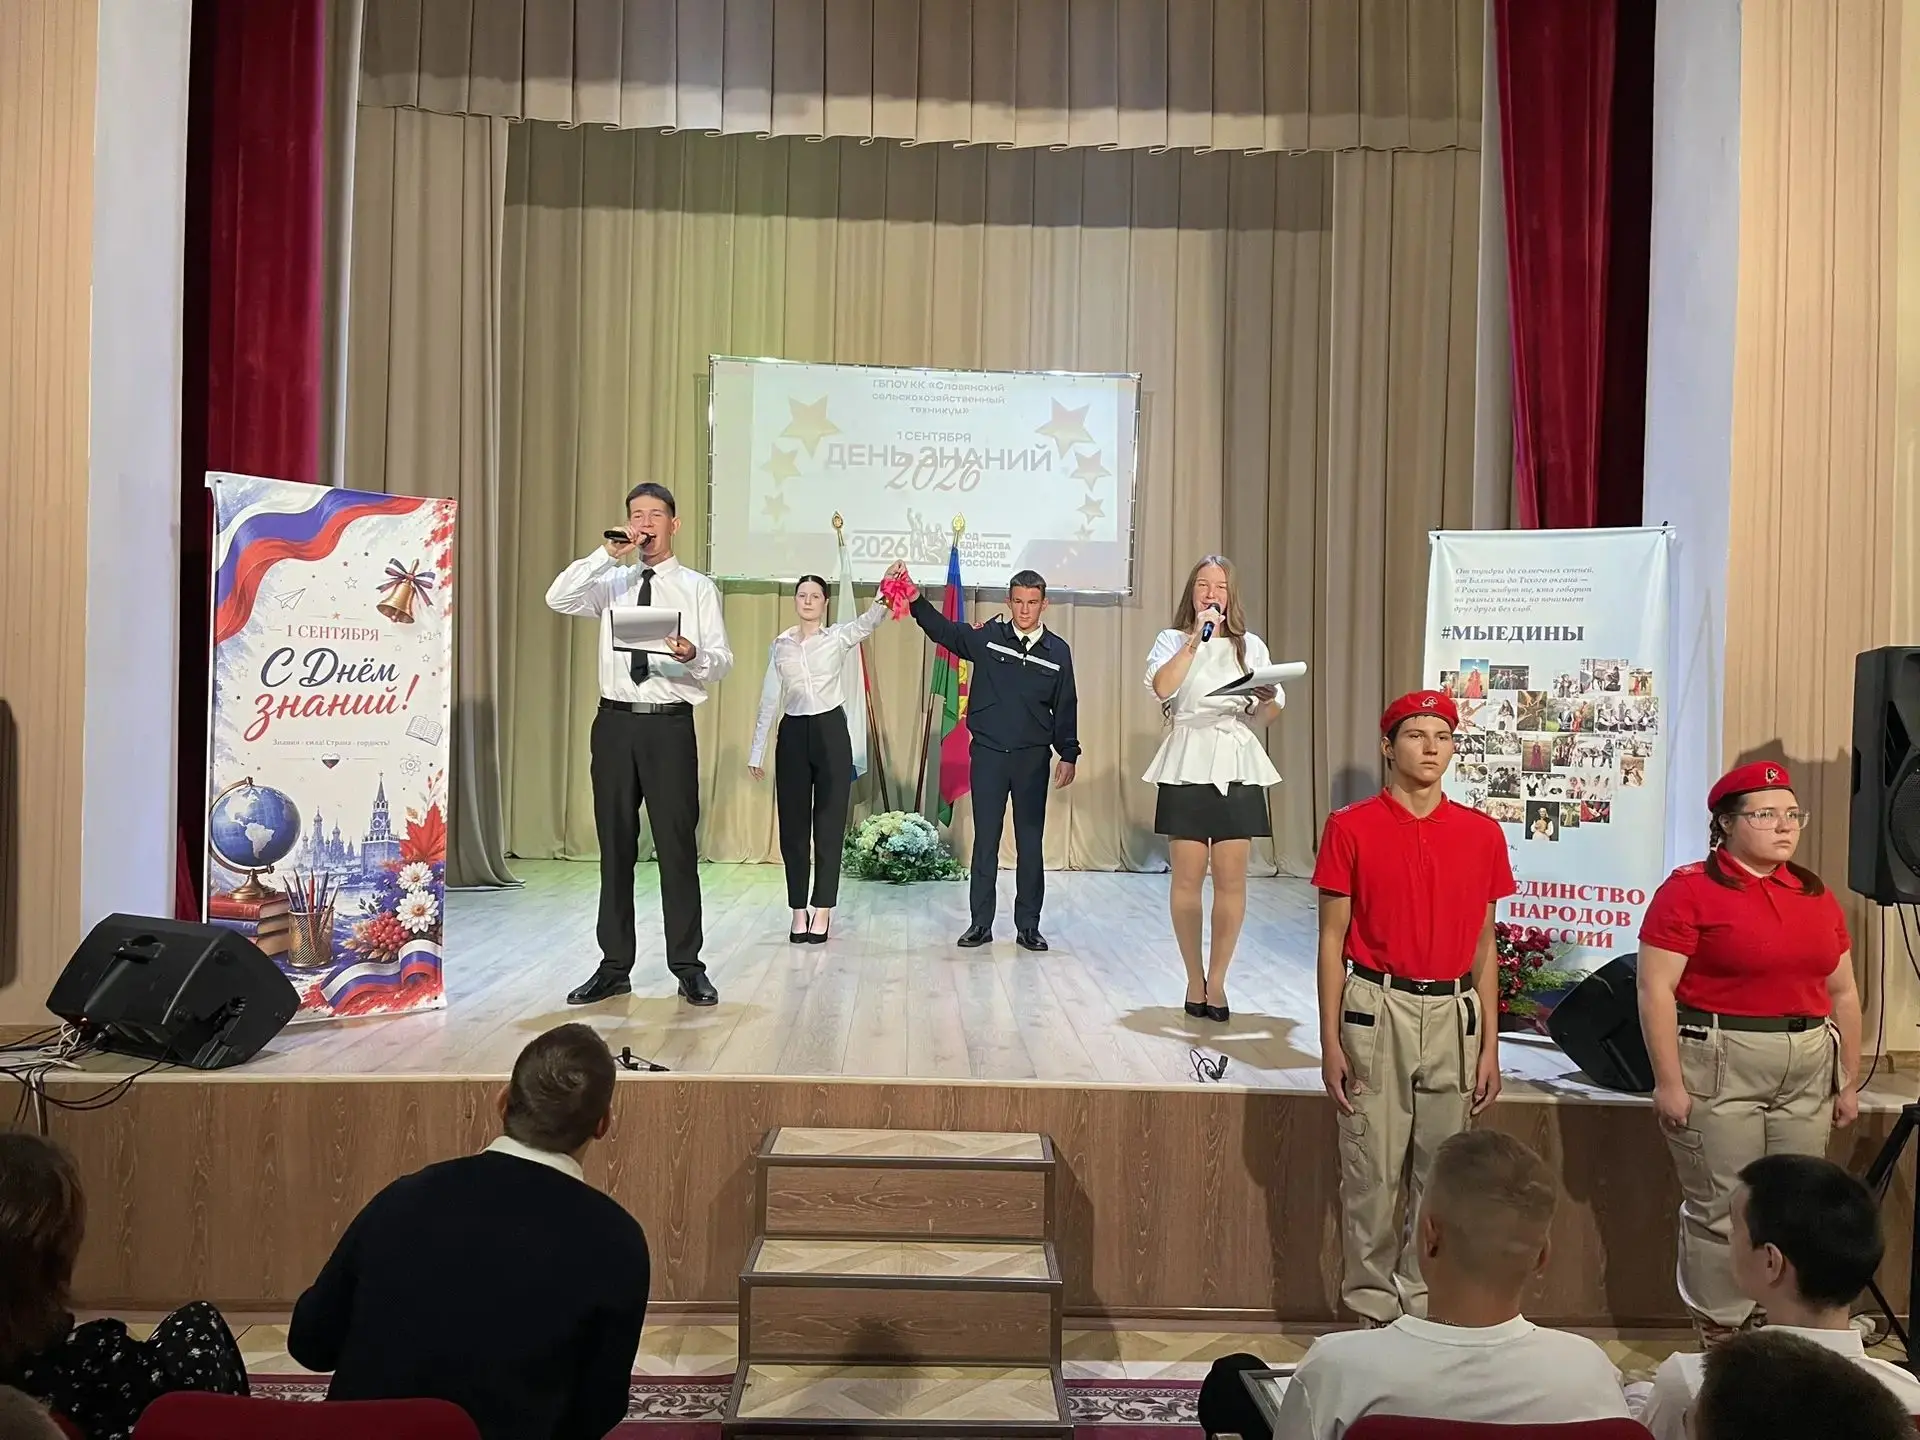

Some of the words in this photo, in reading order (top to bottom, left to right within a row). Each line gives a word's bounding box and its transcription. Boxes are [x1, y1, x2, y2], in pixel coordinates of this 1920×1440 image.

[872, 379, 909, 389] ГБПОУ
[910, 380, 925, 390] КК
[928, 381, 1005, 392] «Славянский
[872, 392, 1005, 404] сельскохозяйственный
[909, 406, 970, 416] техникум»
[904, 431, 972, 443] СЕНТЯБРЯ
[825, 442, 909, 470] ДЕНЬ
[919, 443, 1052, 472] ЗНАНИЙ
[884, 451, 982, 493] 2026
[851, 535, 909, 559] 2026
[959, 541, 1011, 550] ЕДИНСТВА
[959, 550, 1006, 559] НАРОДОВ
[959, 559, 1000, 568] РОССИИ
[287, 624, 293, 637] 1
[298, 624, 379, 641] СЕНТЯБРЯ
[1440, 624, 1585, 644] #МЫЕДИНЫ
[260, 646, 295, 688] С
[298, 647, 400, 688] Днём
[243, 674, 420, 742] знаний!
[1513, 879, 1646, 906] ЕДИНСТВО
[1509, 901, 1632, 928] НАРОДОВ
